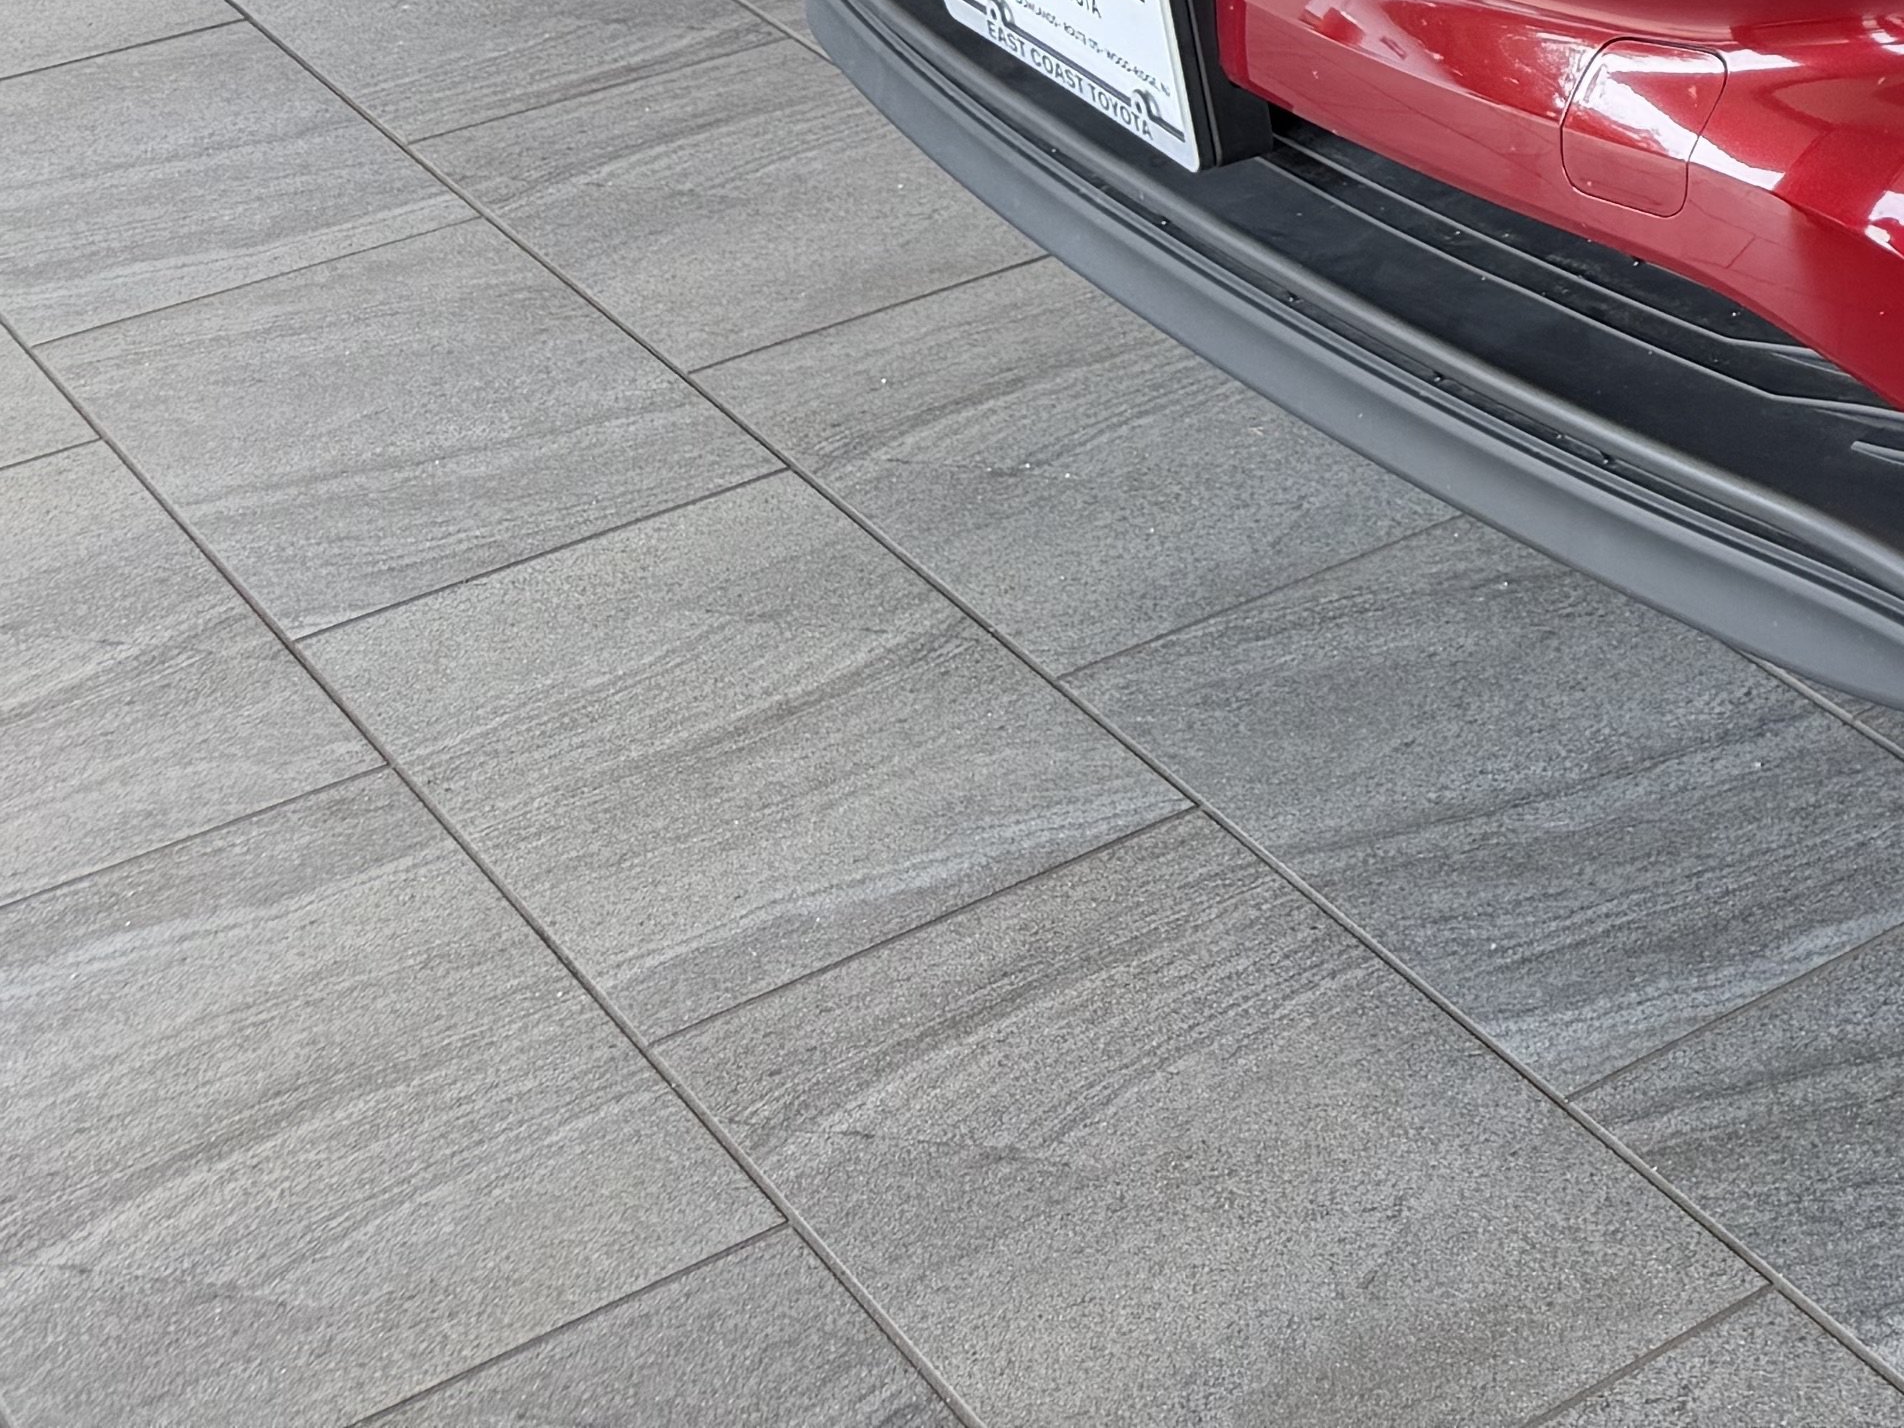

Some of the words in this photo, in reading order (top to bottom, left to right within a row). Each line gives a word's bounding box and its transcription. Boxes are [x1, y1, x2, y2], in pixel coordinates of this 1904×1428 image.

[987, 20, 1025, 57] EAST
[1031, 48, 1084, 94] COAST
[1088, 83, 1153, 140] TOYOTA
